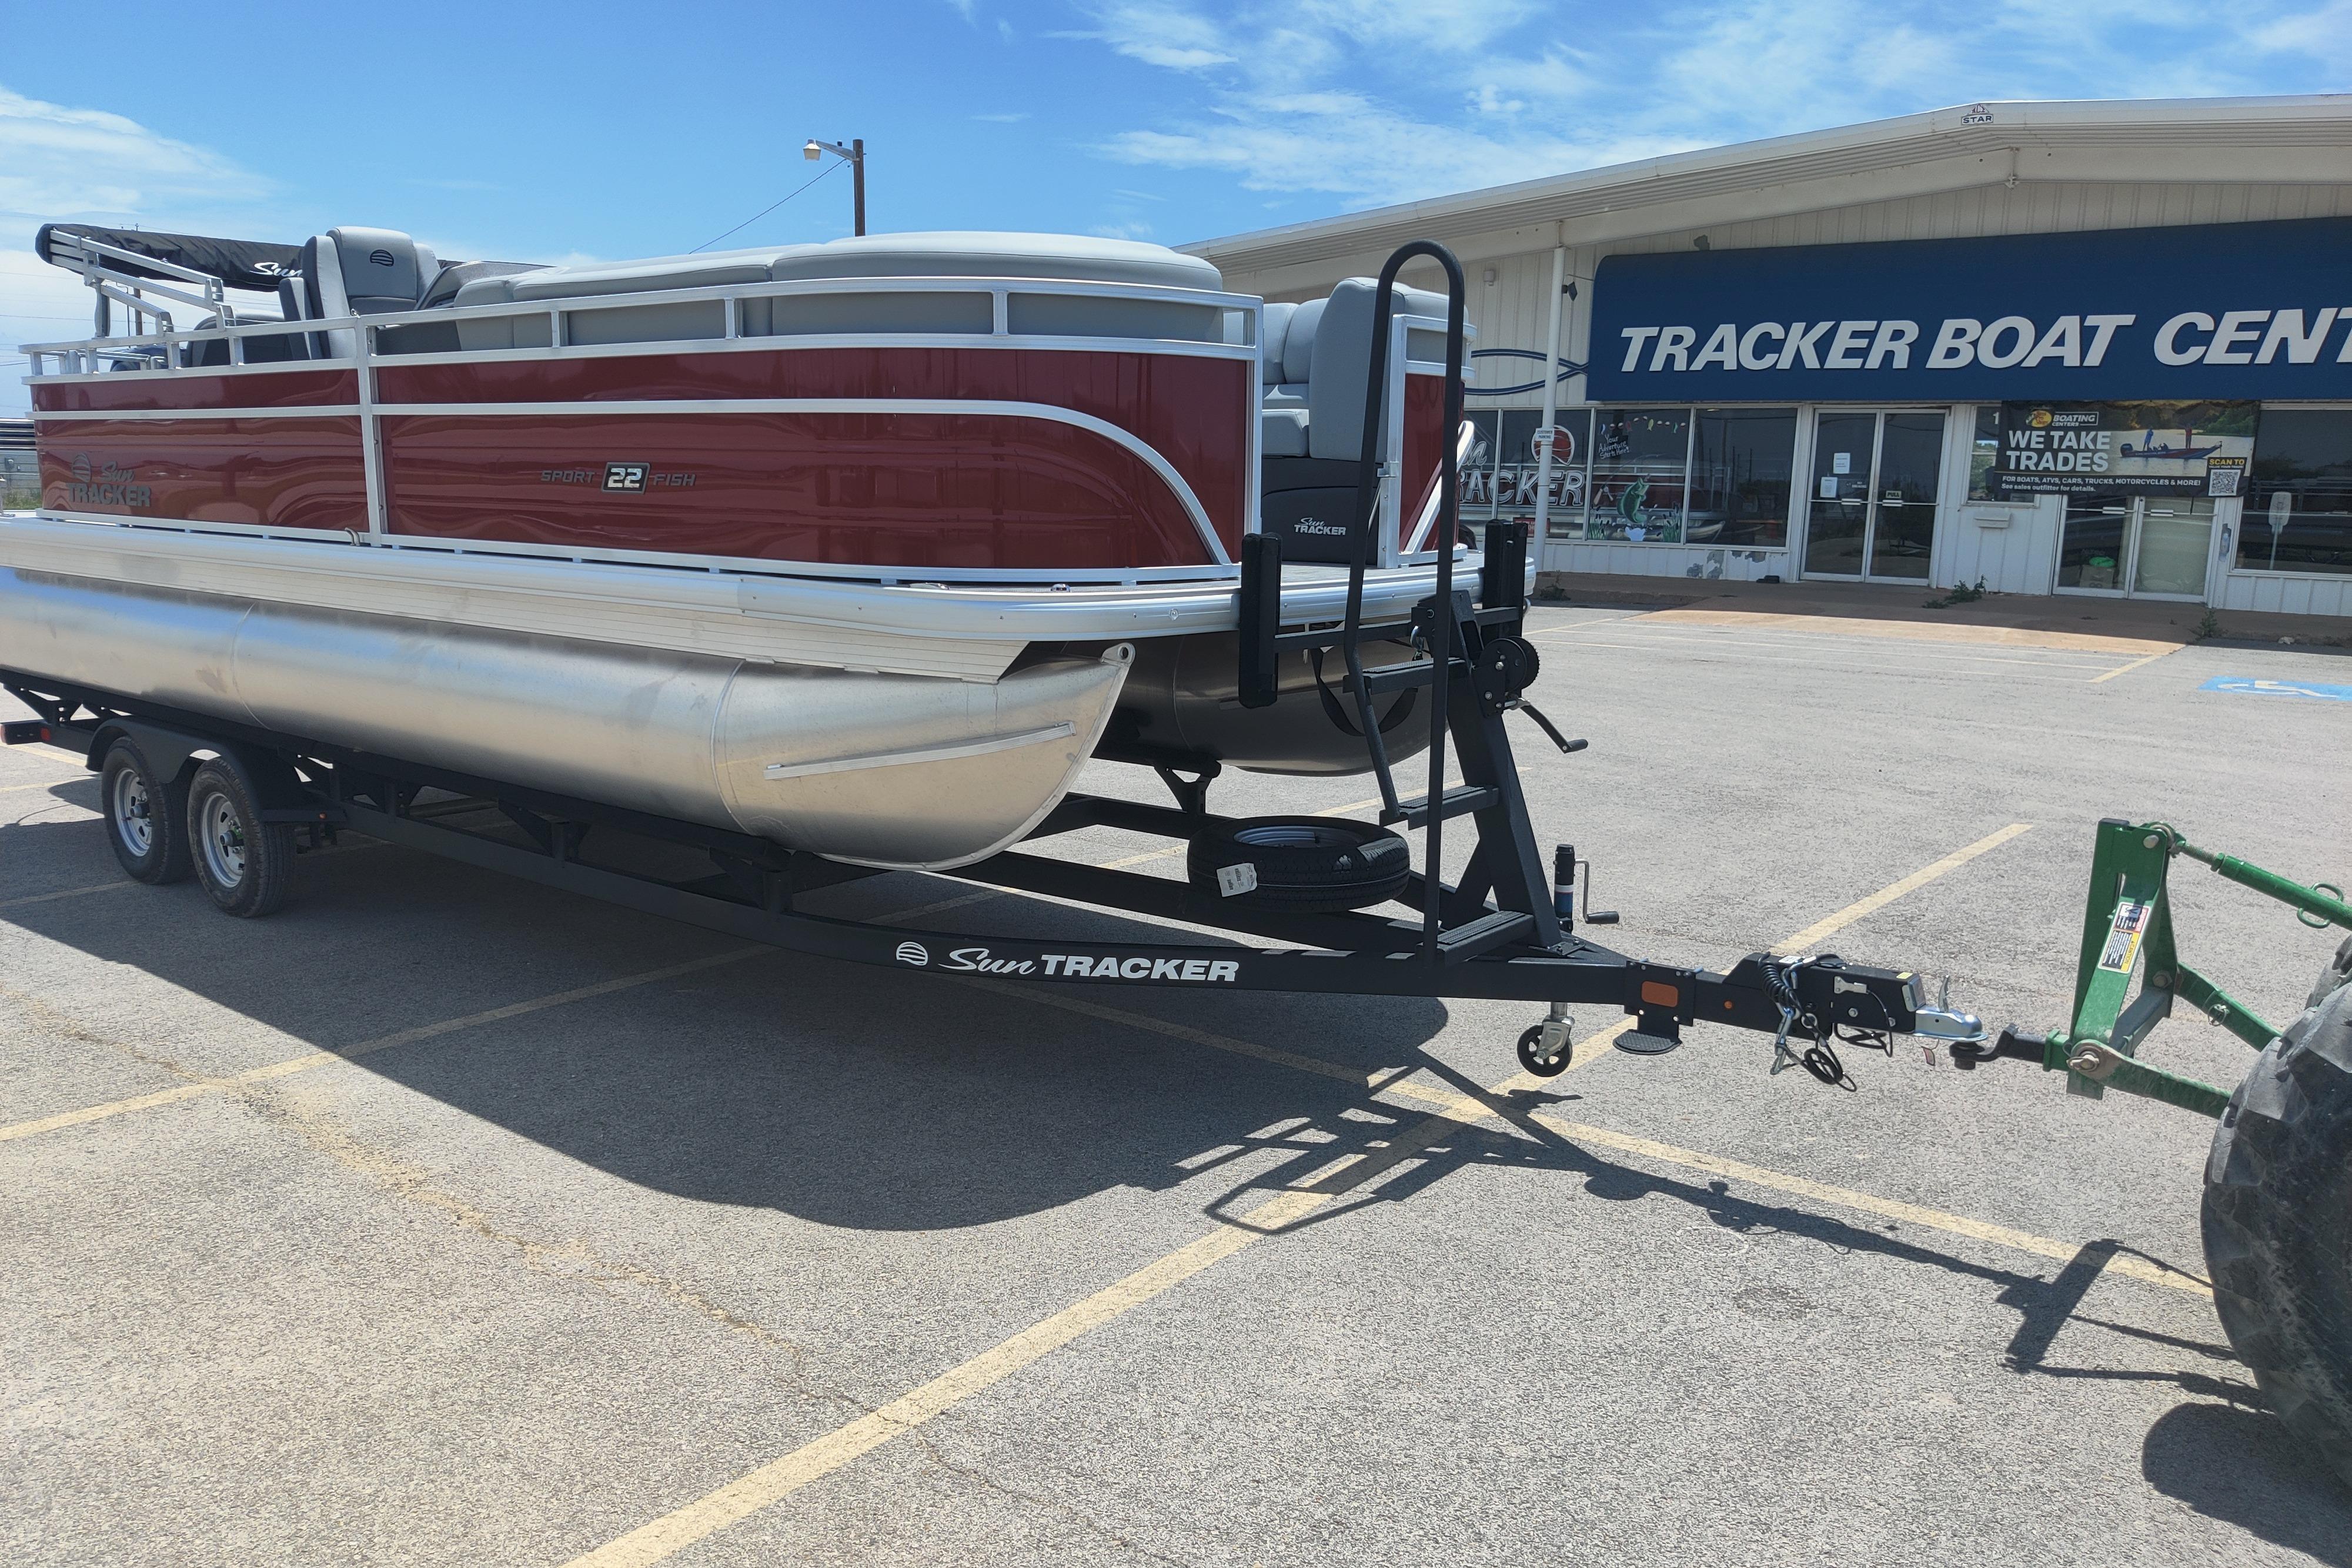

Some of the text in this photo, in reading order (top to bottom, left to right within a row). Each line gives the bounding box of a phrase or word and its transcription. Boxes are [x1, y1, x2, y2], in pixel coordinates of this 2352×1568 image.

[249, 262, 303, 277] Sun
[1621, 320, 1920, 372] TRACKER
[1925, 314, 2136, 369] BOAT
[1599, 441, 1627, 453] Adventure
[1604, 434, 1619, 444] Your
[2009, 430, 2112, 449] WE TAKE
[100, 460, 135, 482] Sun
[2006, 451, 2109, 472] TRADES
[541, 468, 696, 488] SPORT 22 FISH
[66, 482, 151, 507] TRACKER
[1294, 524, 1346, 536] TRACKER
[1298, 517, 1325, 526] Sun
[938, 948, 1240, 982] Sun TRACKER
